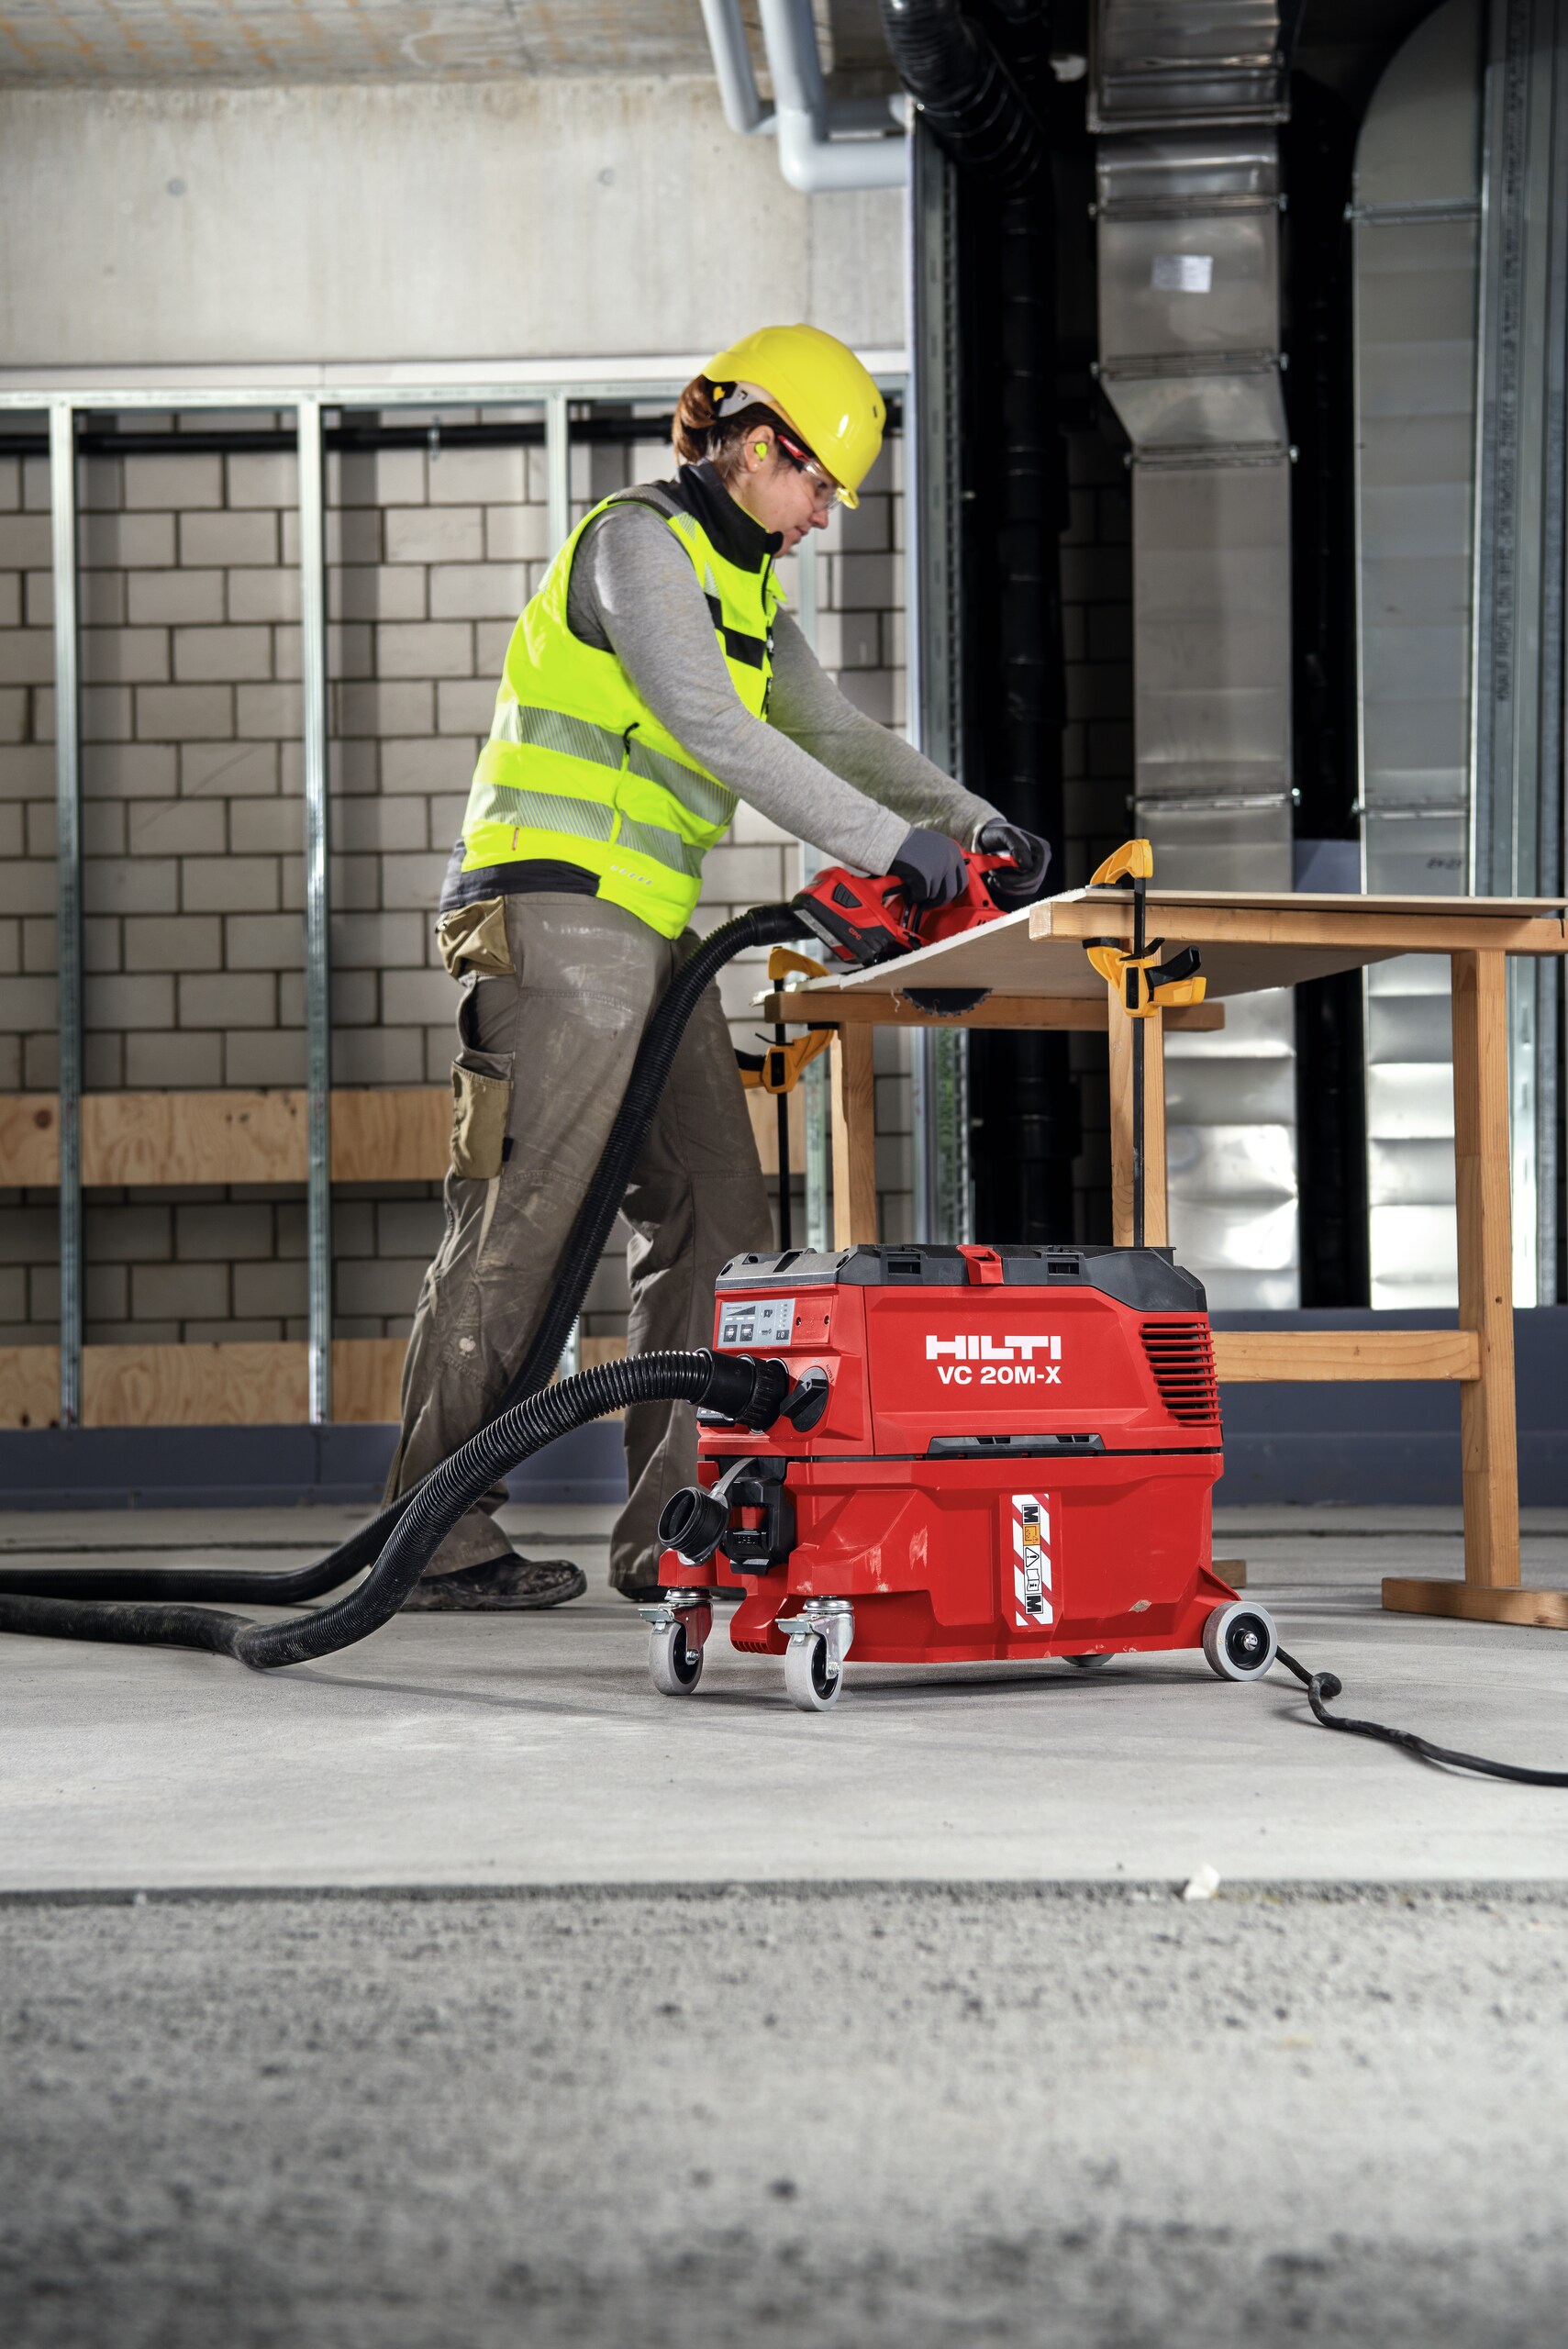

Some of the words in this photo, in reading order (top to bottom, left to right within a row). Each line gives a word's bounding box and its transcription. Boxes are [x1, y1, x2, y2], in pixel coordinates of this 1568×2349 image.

[926, 1335, 1062, 1360] HILTI
[937, 1365, 973, 1385] VC
[980, 1365, 1062, 1385] 20M-X
[1023, 1506, 1039, 1523] M
[1026, 1595, 1042, 1613] M
